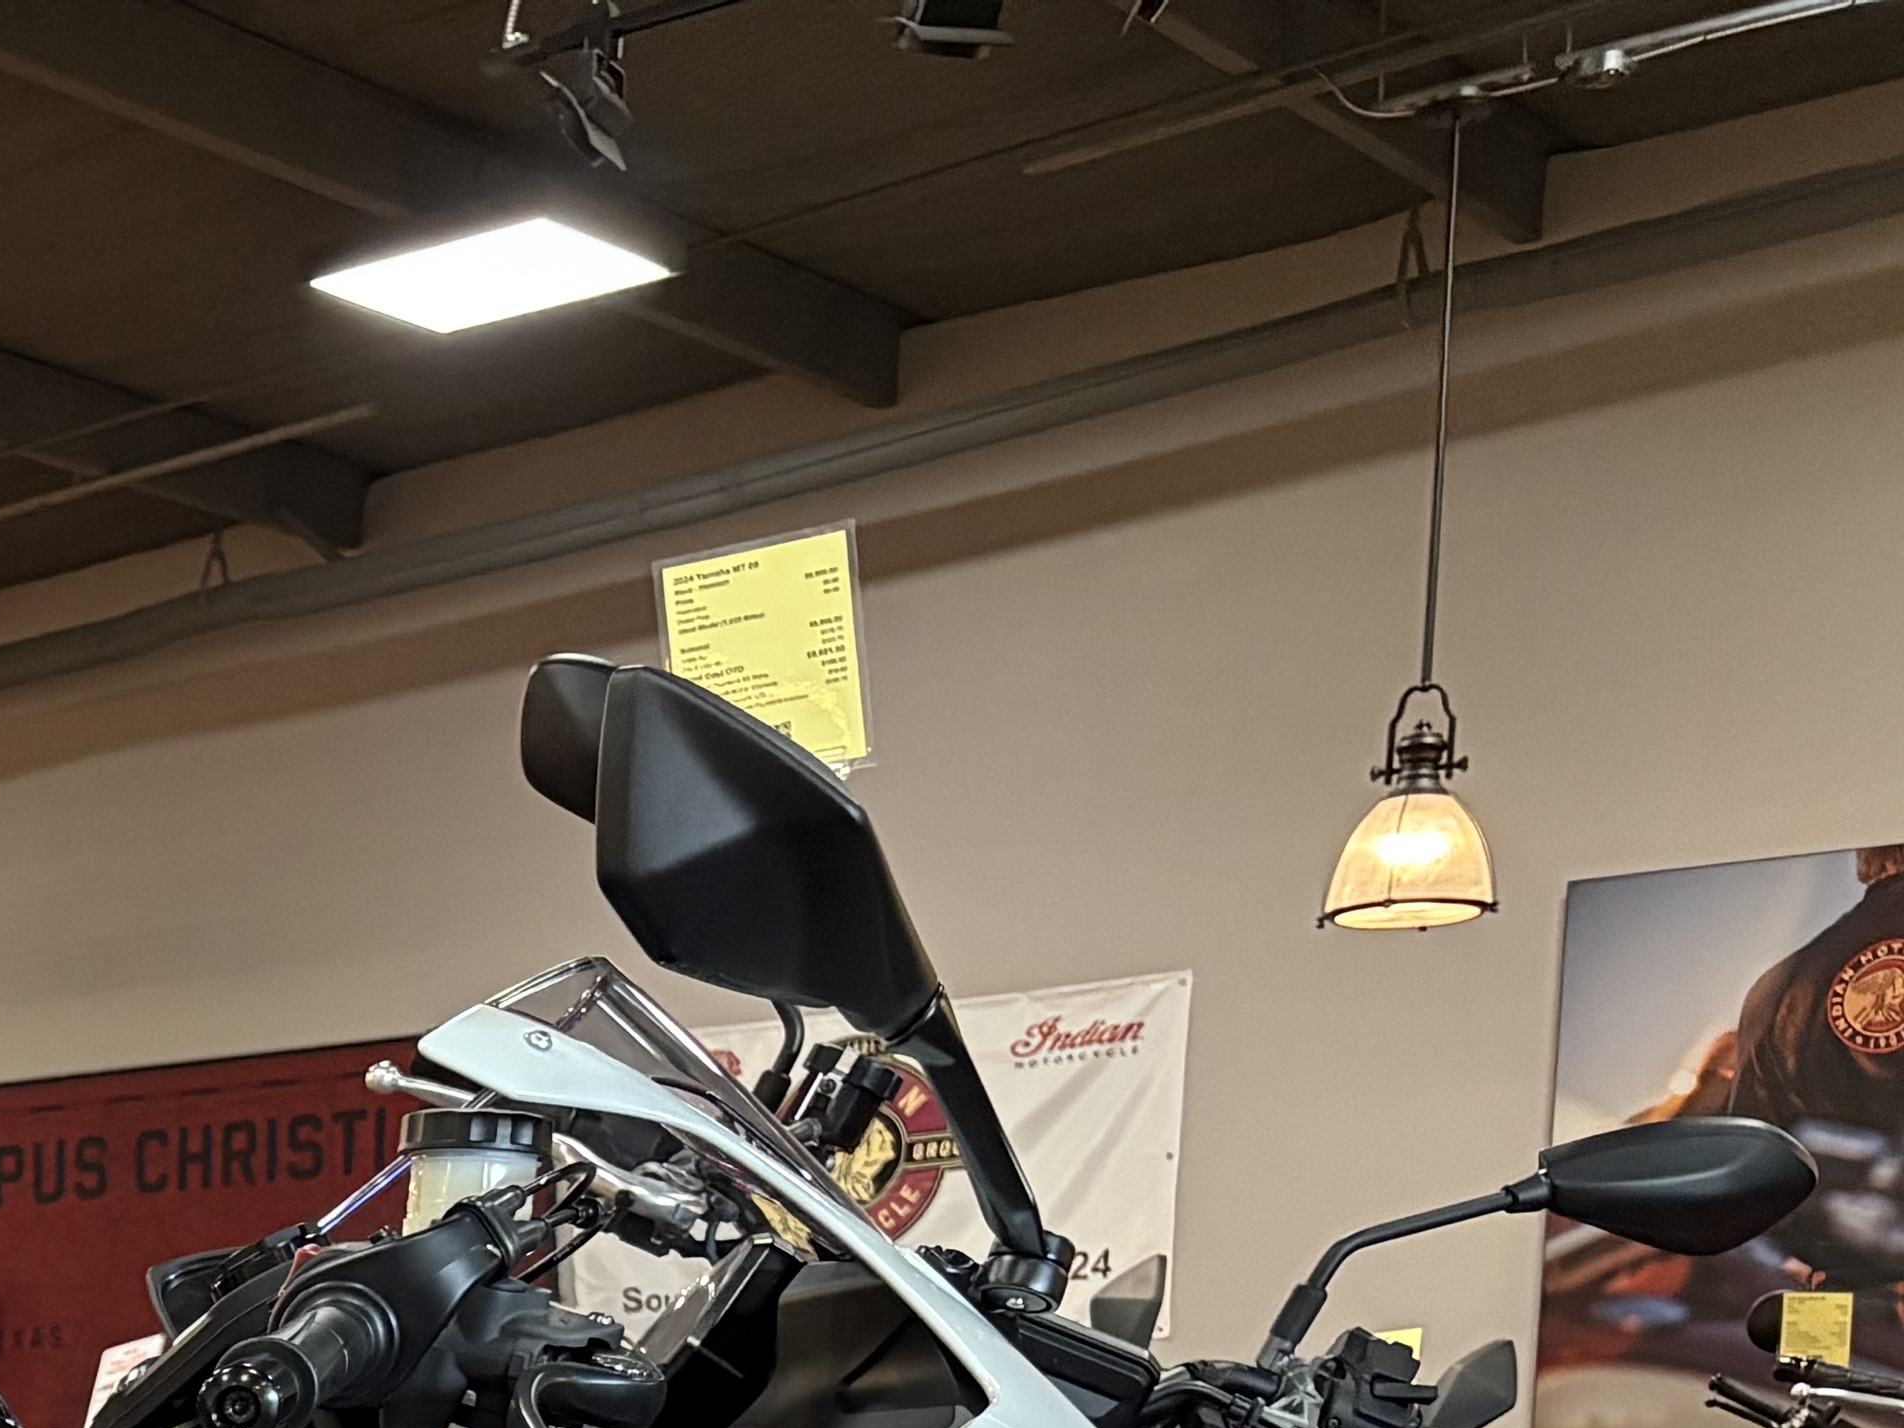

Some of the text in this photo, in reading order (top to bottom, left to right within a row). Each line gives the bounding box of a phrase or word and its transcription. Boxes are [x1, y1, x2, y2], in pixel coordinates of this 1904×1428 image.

[696, 567, 731, 581] Yamaha
[1010, 1014, 1145, 1059] Indian
[1013, 1044, 1141, 1070] MOTORCYCLE
[134, 1106, 388, 1195] CHRISTI
